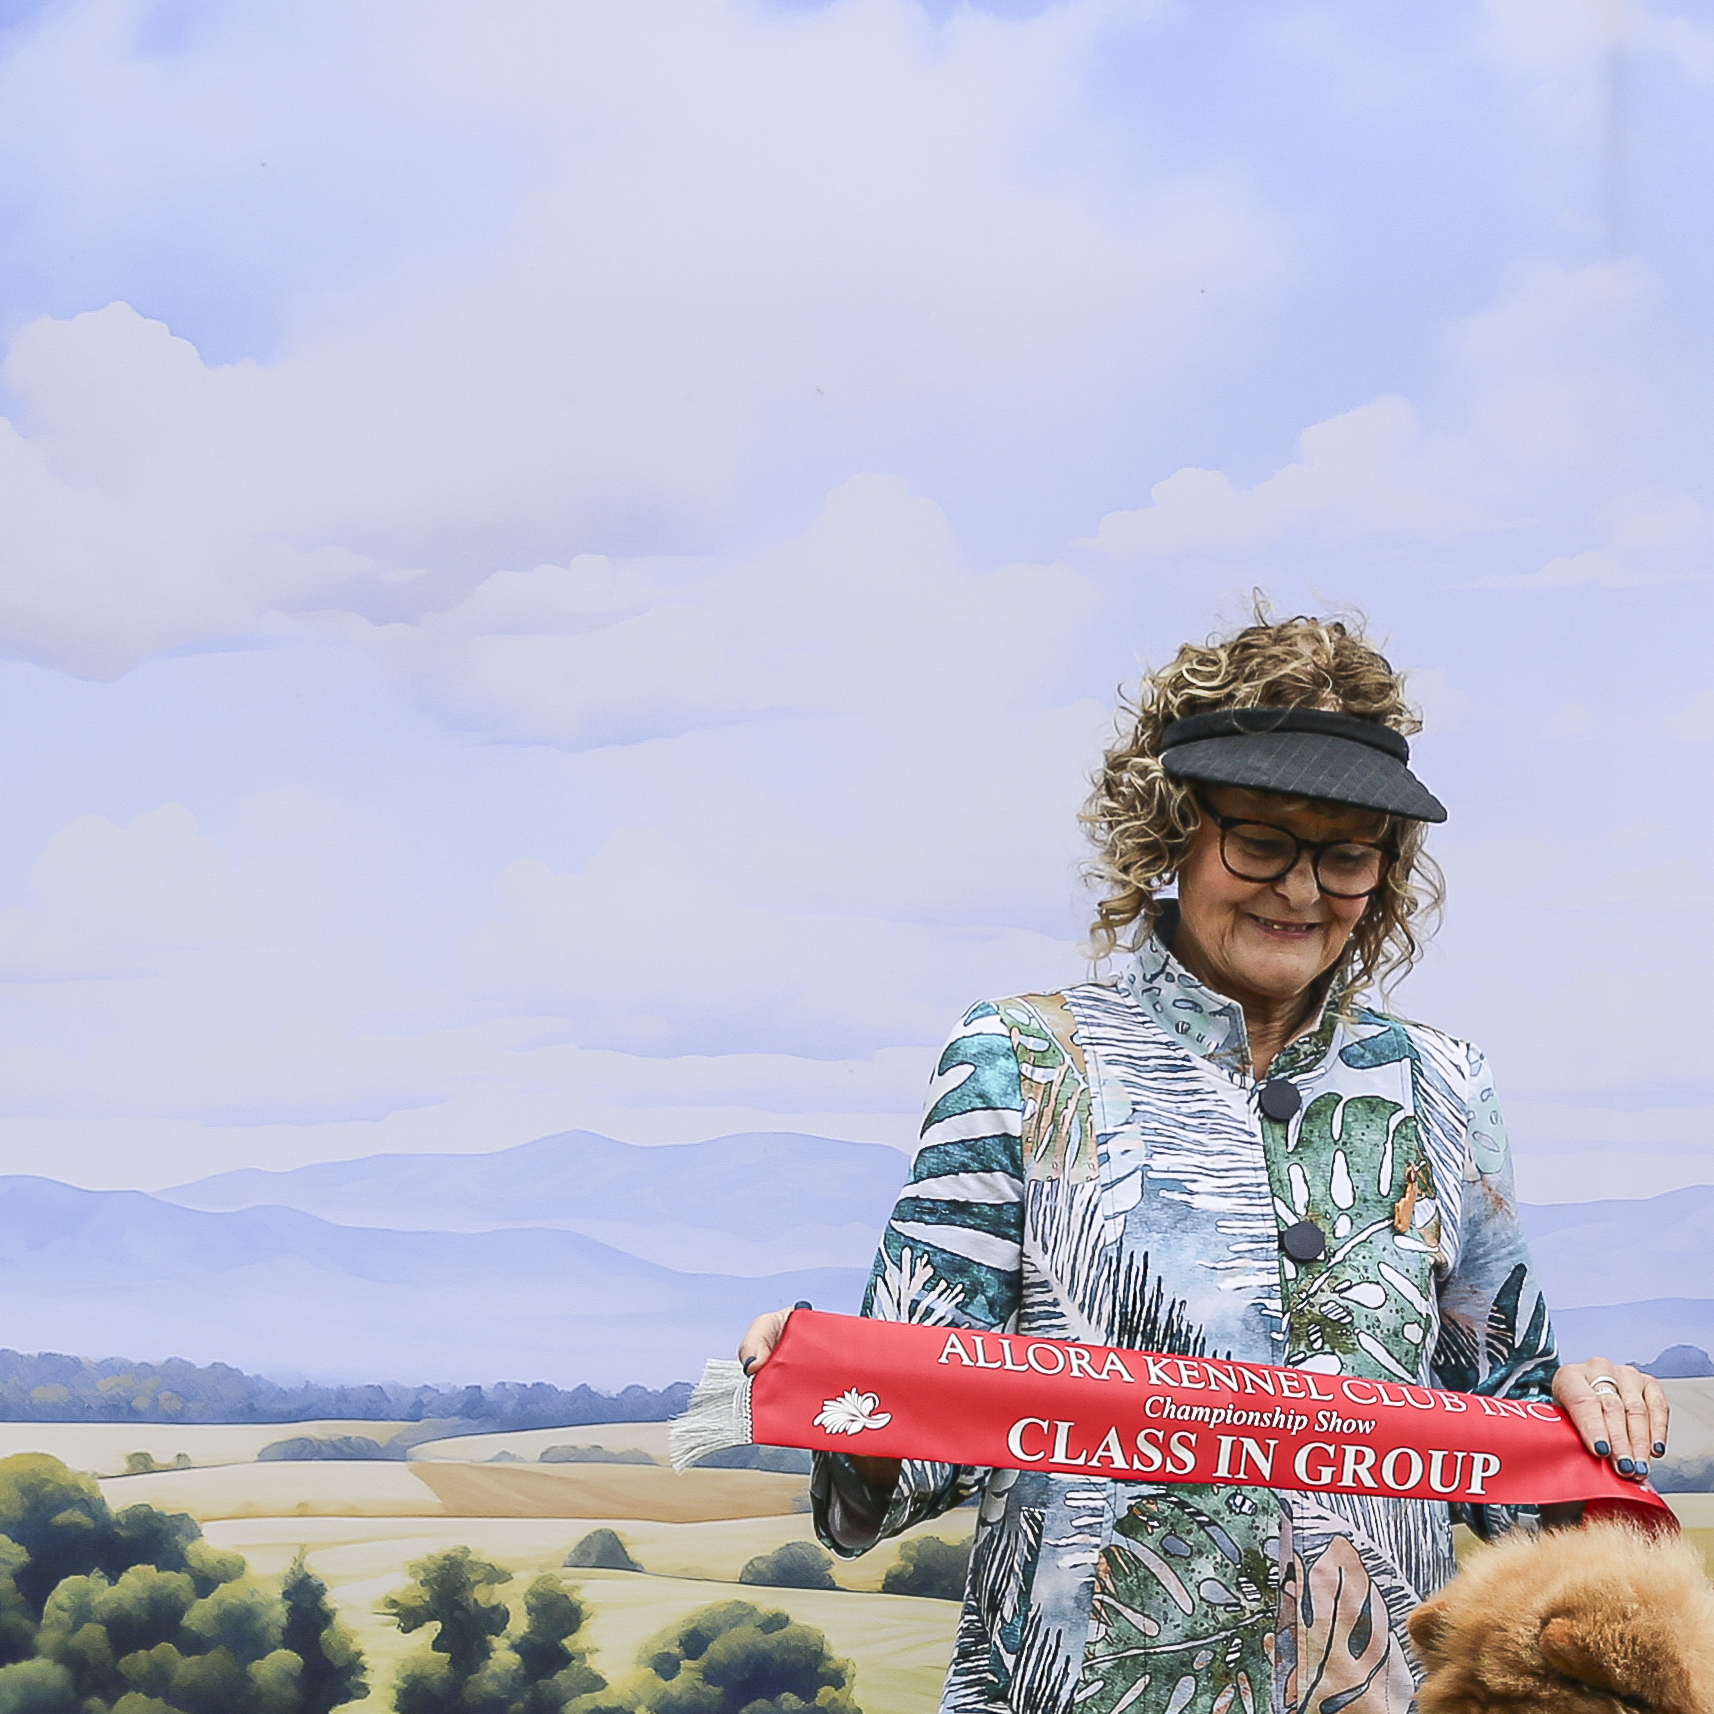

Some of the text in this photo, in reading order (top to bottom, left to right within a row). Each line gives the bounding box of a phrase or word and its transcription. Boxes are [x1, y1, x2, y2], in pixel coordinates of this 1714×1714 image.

[937, 1330, 1563, 1424] ALLORA KENNEL CLUB INC
[1142, 1395, 1377, 1435] Championship Show
[1007, 1417, 1501, 1496] CLASS IN GROUP
